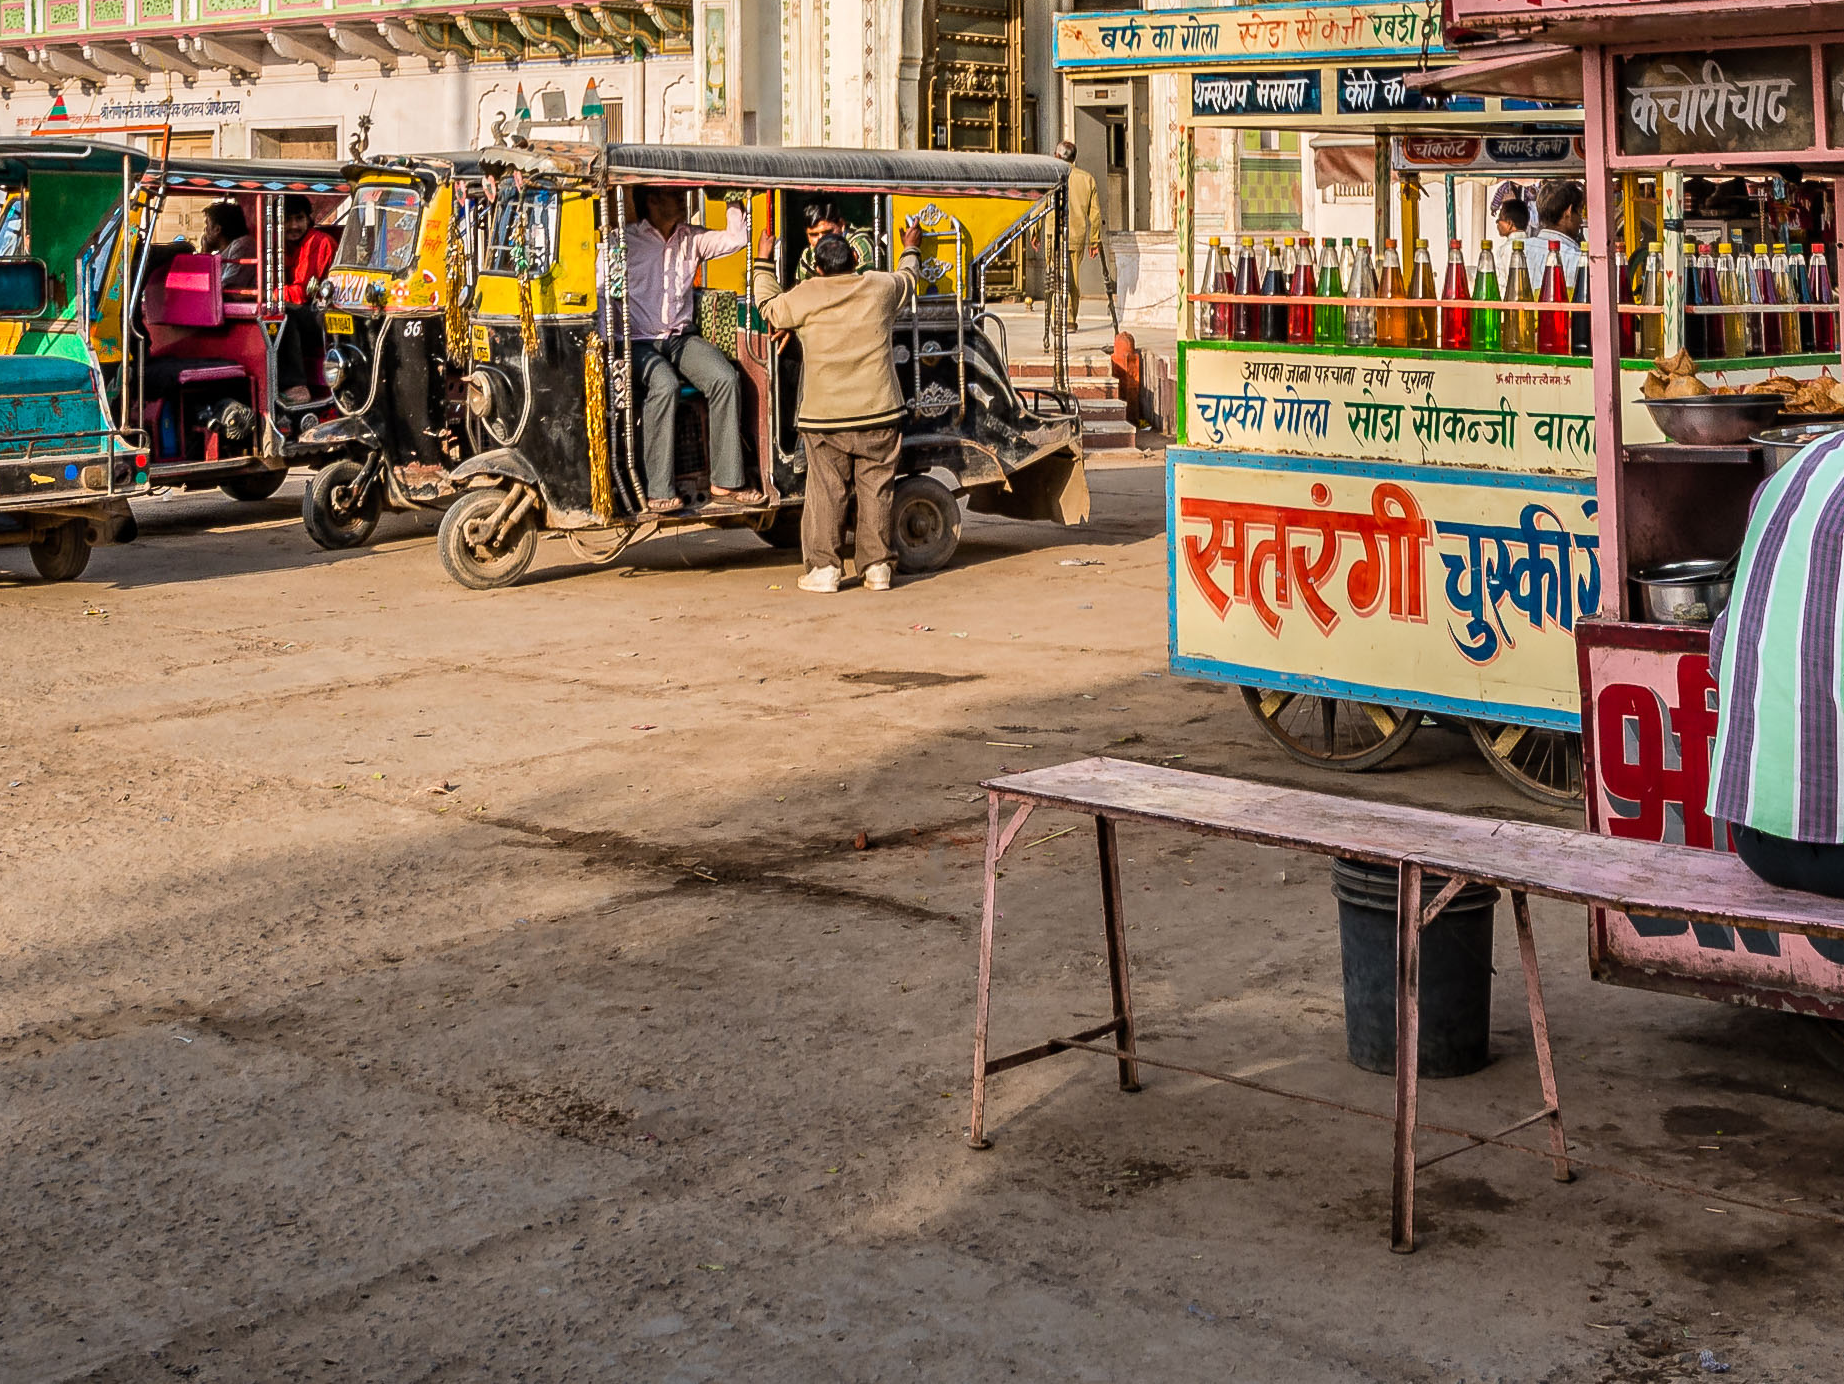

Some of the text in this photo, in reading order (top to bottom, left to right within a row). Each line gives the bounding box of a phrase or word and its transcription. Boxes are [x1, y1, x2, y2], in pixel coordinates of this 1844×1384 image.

[1098, 17, 1147, 52] बर्फ
[1150, 24, 1177, 52] का
[1180, 15, 1220, 53] गोला
[1237, 13, 1290, 51] सोडा
[1368, 4, 1419, 45] रबड़ी
[1344, 68, 1377, 112] केरी
[404, 321, 422, 336] 36
[1243, 361, 1283, 384] आपका
[1286, 362, 1311, 385] जाना
[1314, 363, 1355, 387] पहचाना
[1396, 368, 1435, 394] पुराना
[1195, 383, 1266, 444] चुस्की
[1273, 385, 1332, 439] गोला
[1344, 388, 1405, 442] सोडा
[1410, 393, 1519, 451] सीकन्जी
[1180, 482, 1433, 639] सतरंगी
[1434, 502, 1575, 667] चुस्की
